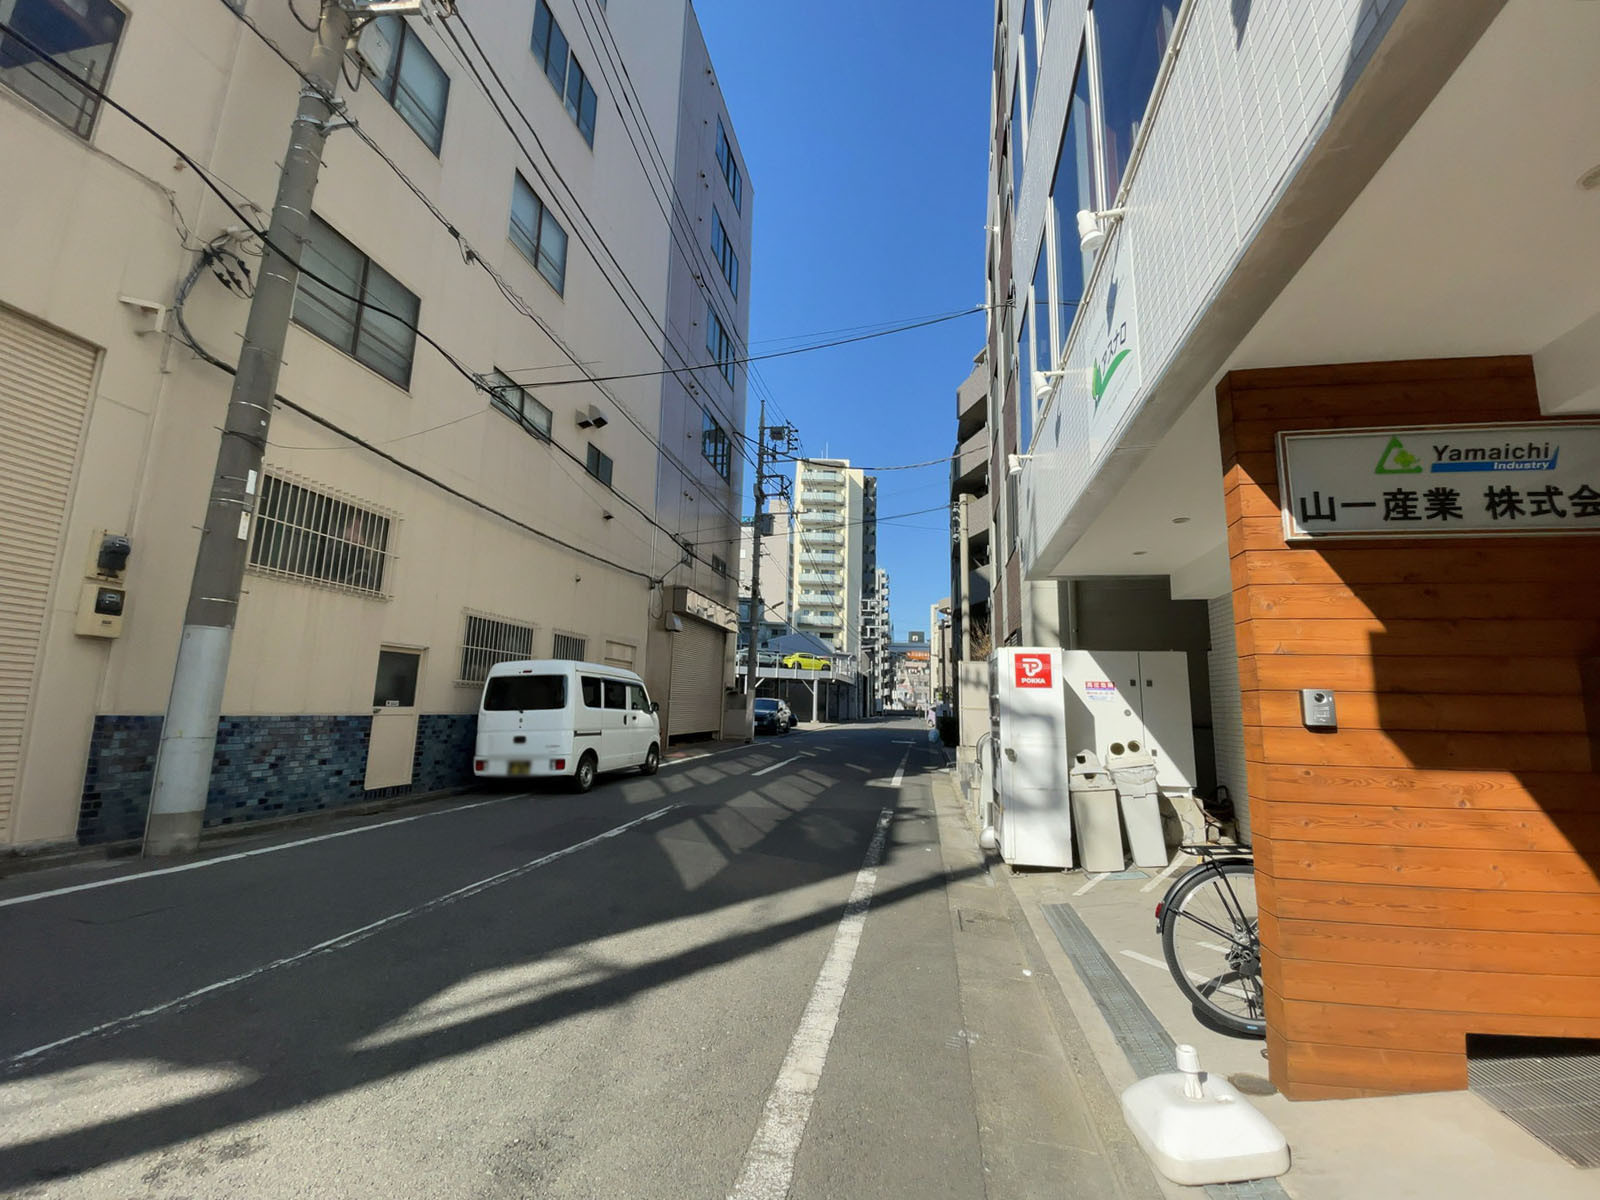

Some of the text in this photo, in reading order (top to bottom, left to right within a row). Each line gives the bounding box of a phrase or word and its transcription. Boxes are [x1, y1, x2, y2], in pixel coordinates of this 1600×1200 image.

[1432, 442, 1549, 462] Yamaichi
[1493, 460, 1550, 471] Industry
[1300, 488, 1463, 522] 山一産業
